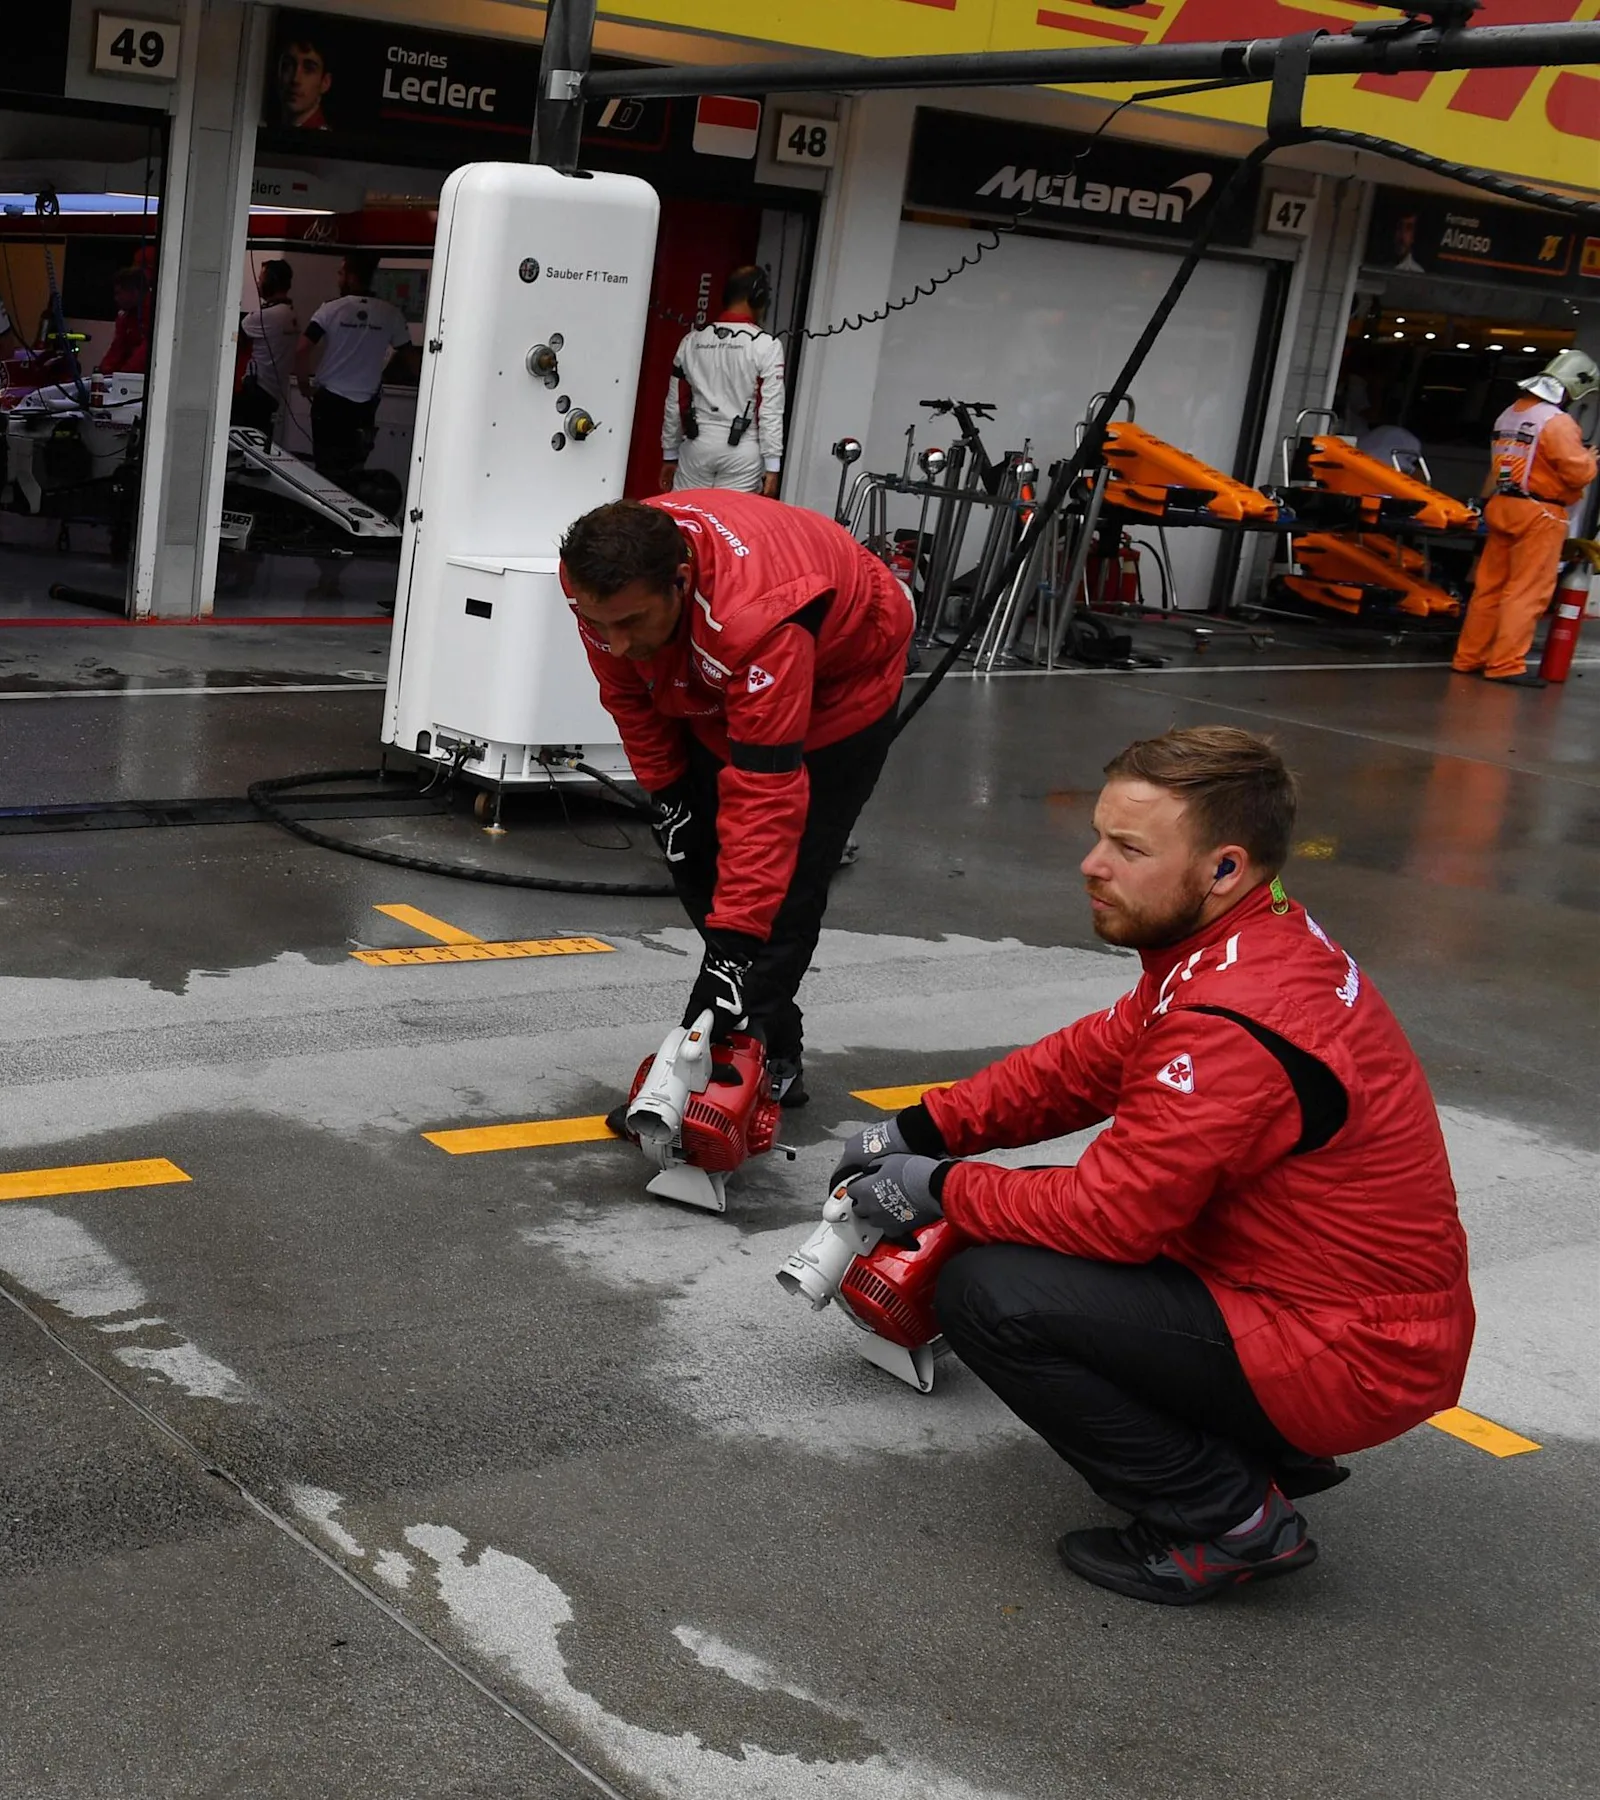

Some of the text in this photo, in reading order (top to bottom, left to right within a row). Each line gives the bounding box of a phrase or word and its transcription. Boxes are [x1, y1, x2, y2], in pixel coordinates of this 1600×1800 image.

[110, 28, 164, 68] 49
[386, 46, 449, 69] Charles
[382, 67, 497, 113] Leclerc
[788, 125, 827, 157] 48
[975, 165, 1184, 224] McLaren
[1276, 201, 1307, 229] 47
[1440, 227, 1492, 254] Alonso
[546, 266, 584, 281] Sauber
[602, 271, 629, 284] Team
[696, 271, 713, 325] eam
[222, 510, 251, 526] OWER
[702, 512, 750, 558] Sauber
[702, 660, 723, 680] OMP
